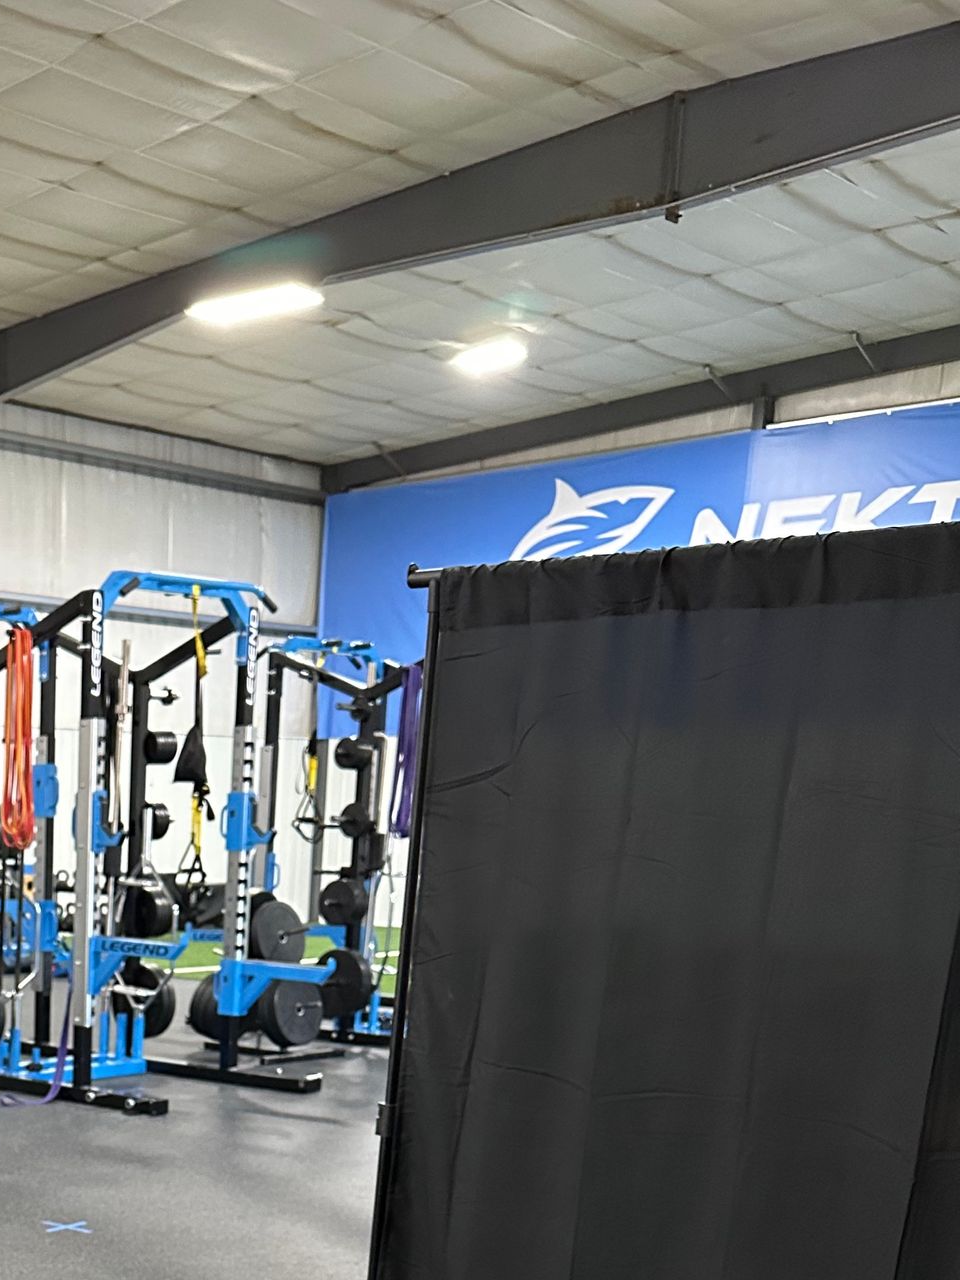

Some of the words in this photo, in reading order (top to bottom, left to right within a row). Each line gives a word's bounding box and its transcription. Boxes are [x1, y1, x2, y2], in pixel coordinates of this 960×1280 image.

[90, 591, 103, 698] LEGEND
[245, 607, 260, 706] LEGEND
[101, 941, 169, 957] LEGEND
